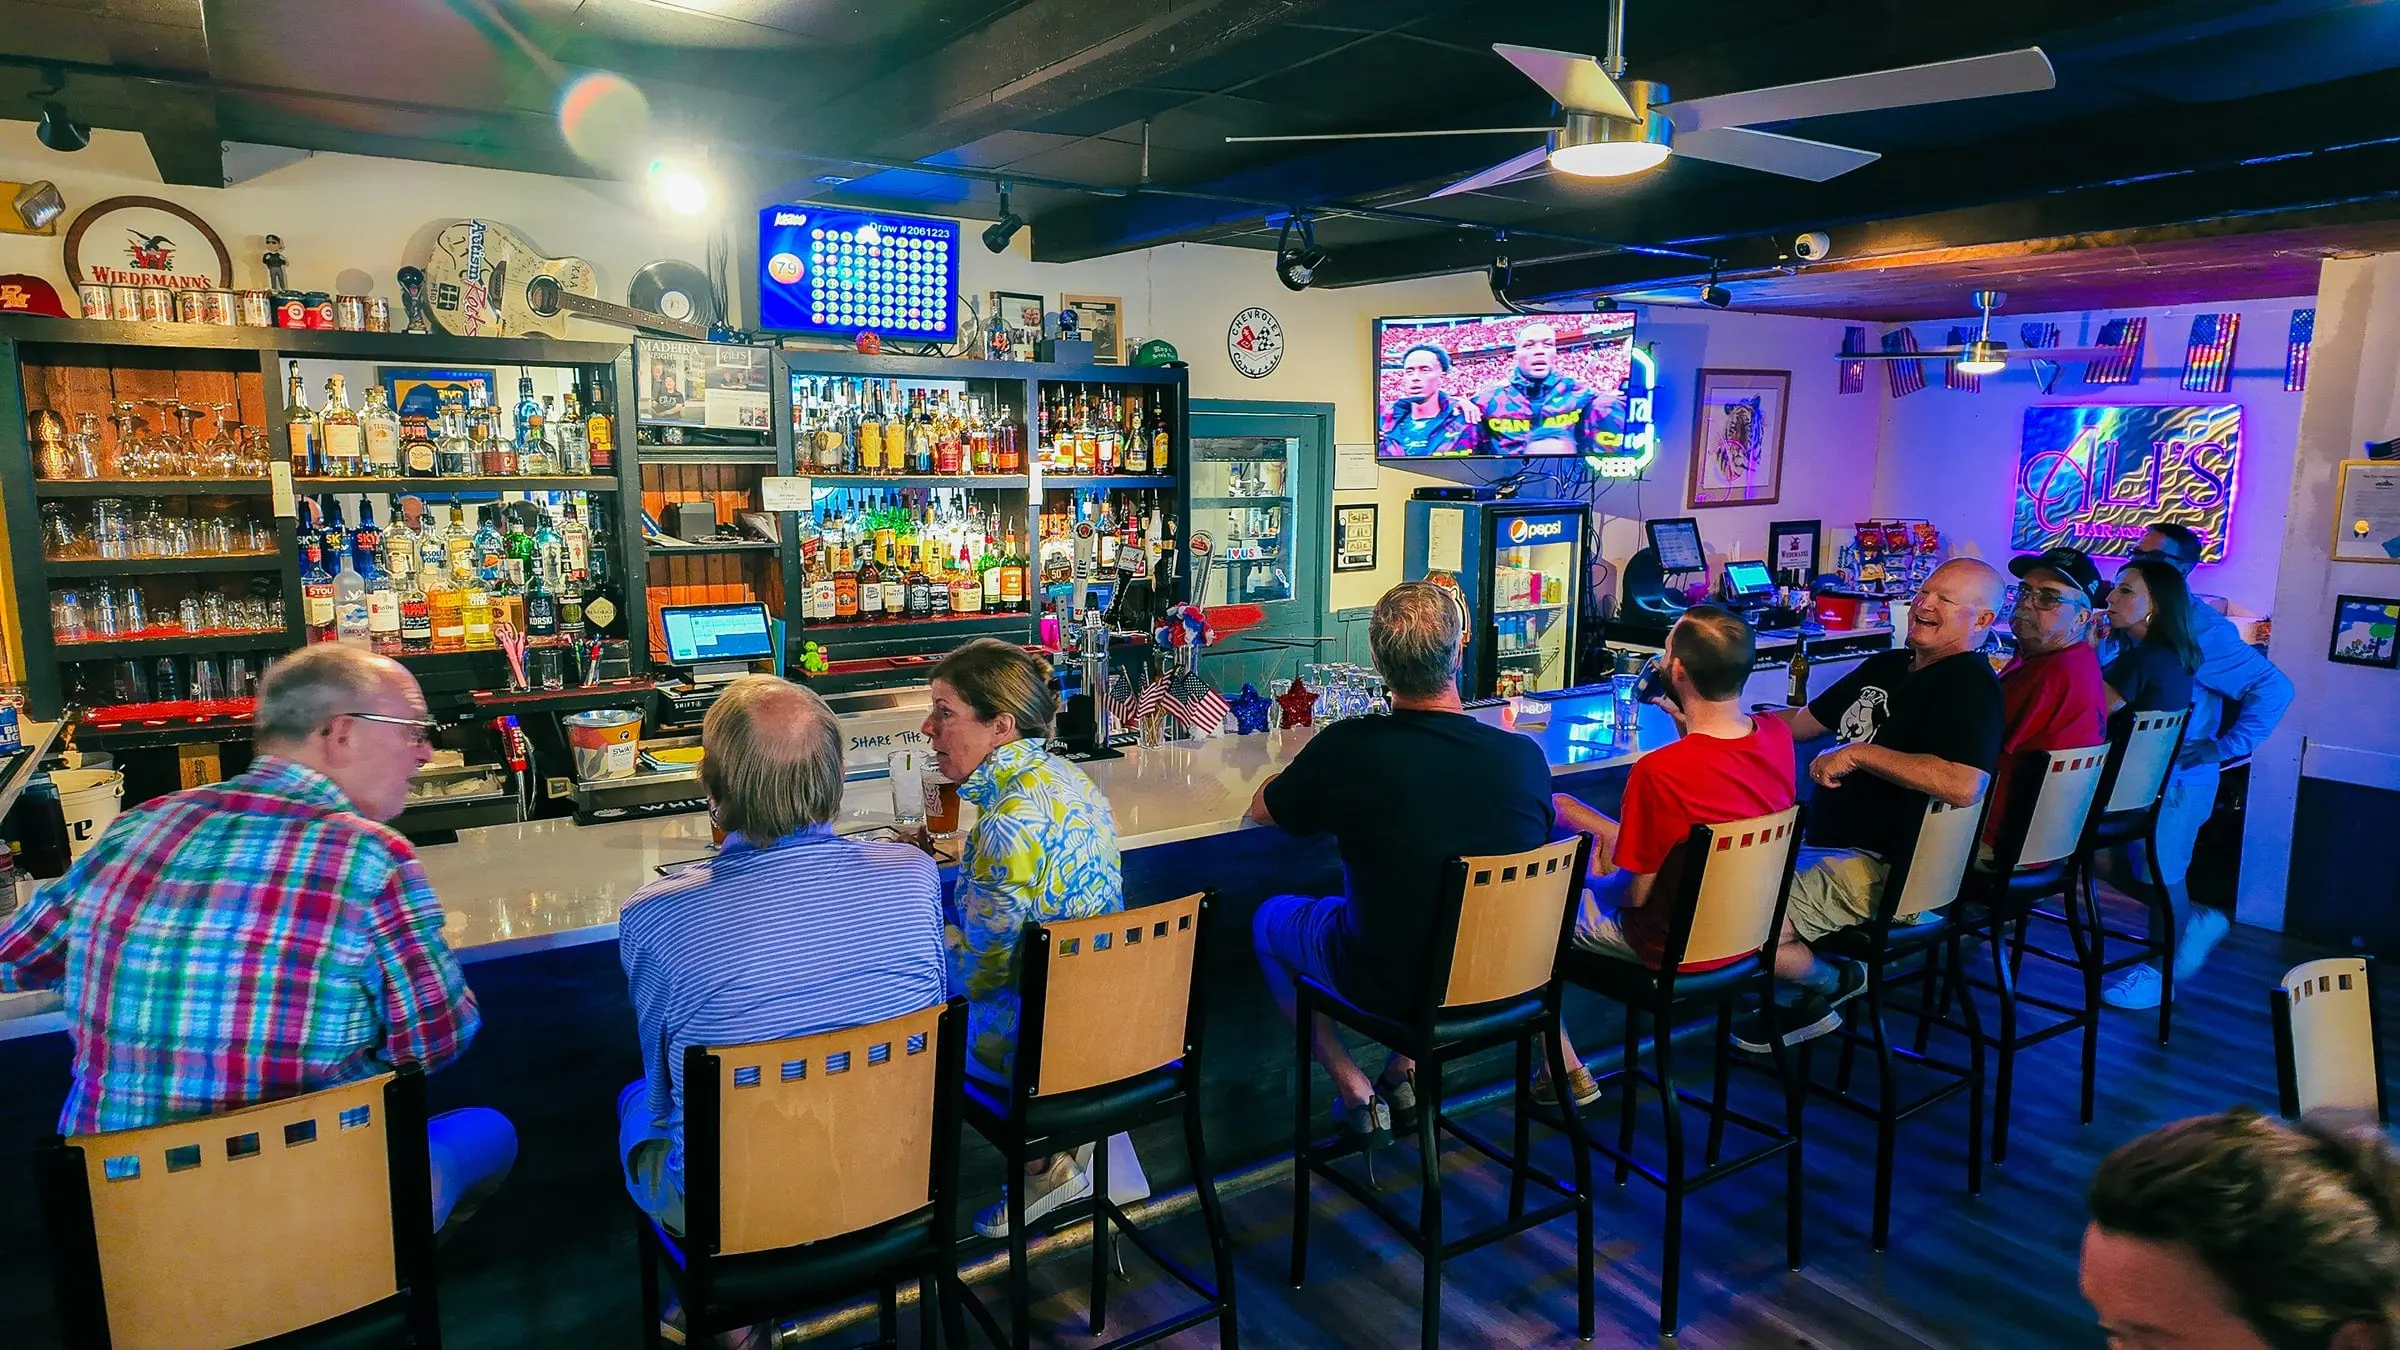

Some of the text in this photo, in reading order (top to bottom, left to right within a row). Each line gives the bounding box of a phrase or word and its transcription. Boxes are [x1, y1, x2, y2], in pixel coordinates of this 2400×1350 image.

[869, 222, 950, 239] Draw #2061223
[469, 218, 487, 281] Autism
[776, 261, 797, 275] 79
[1232, 310, 1281, 338] CHEVROLET
[640, 341, 700, 355] MADEIRA
[2021, 424, 2227, 533] ALI'S
[1528, 520, 1561, 539] pepsi
[2074, 522, 2113, 538] BAR
[1051, 569, 1062, 579] 50
[850, 730, 922, 751] SHARE THE
